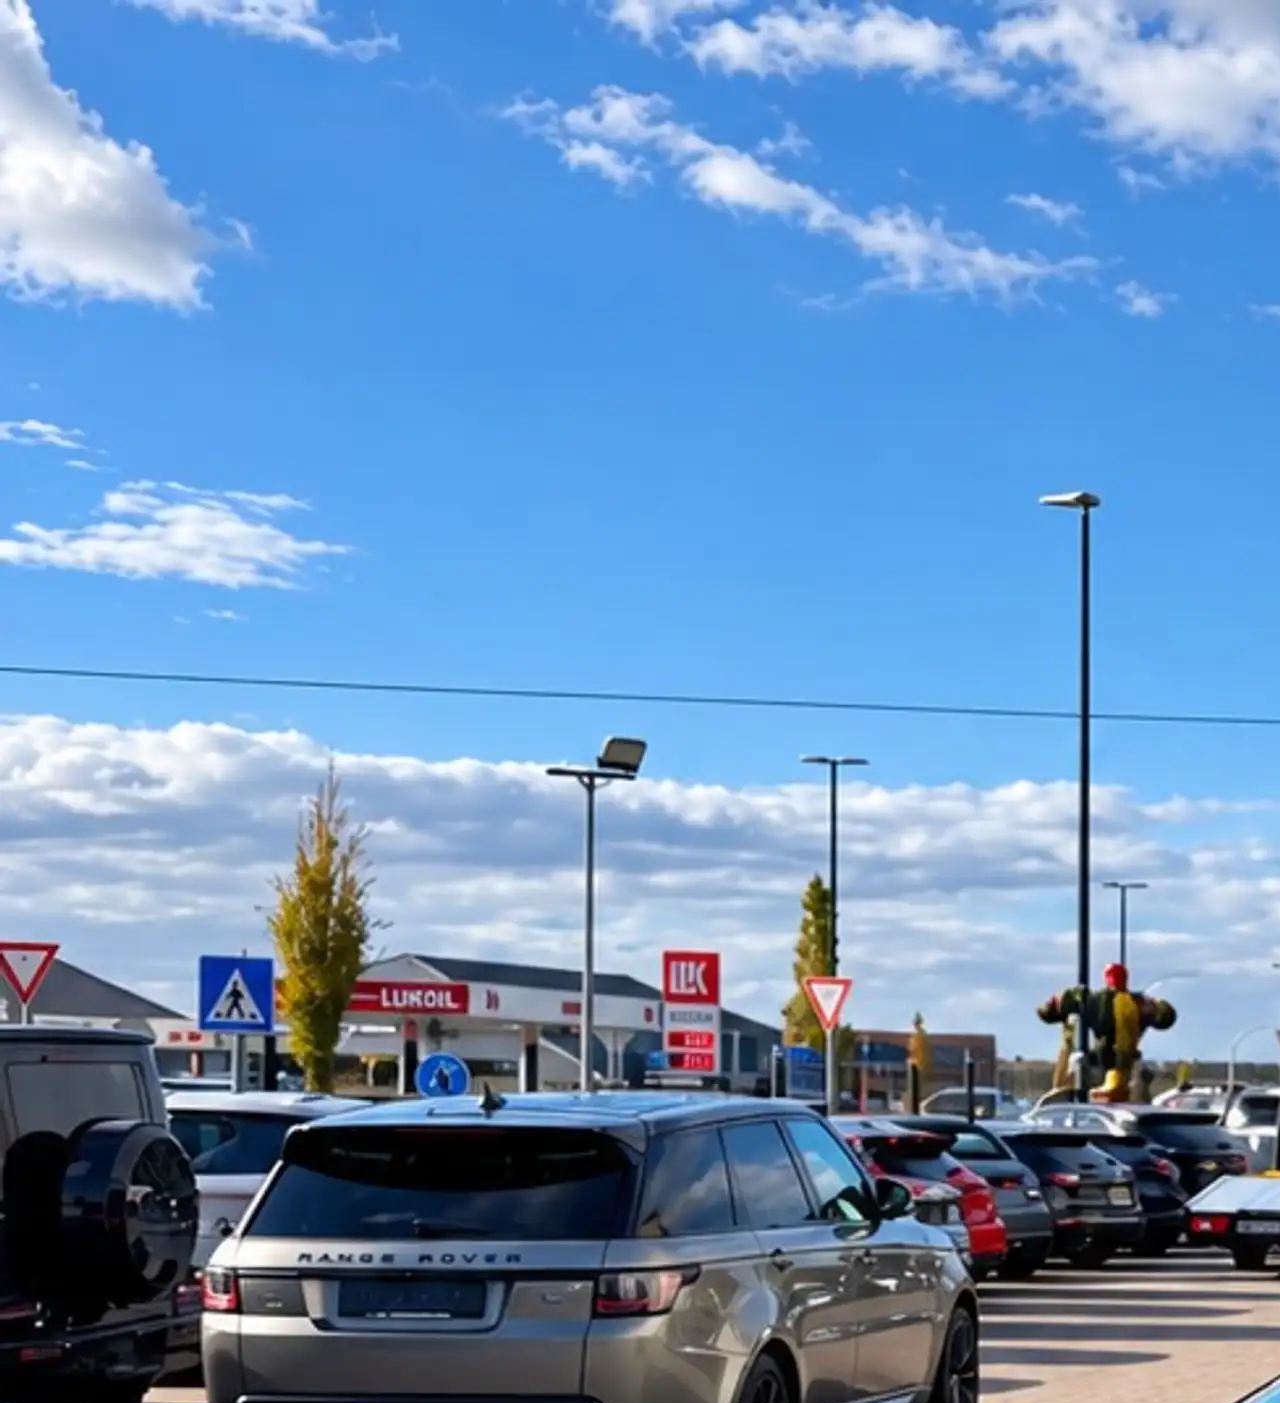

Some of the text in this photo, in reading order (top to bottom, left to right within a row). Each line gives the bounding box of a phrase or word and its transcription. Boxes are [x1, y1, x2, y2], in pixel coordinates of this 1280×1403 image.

[381, 987, 460, 1009] LUKOIL
[297, 1252, 523, 1265] RANGE ROVER
